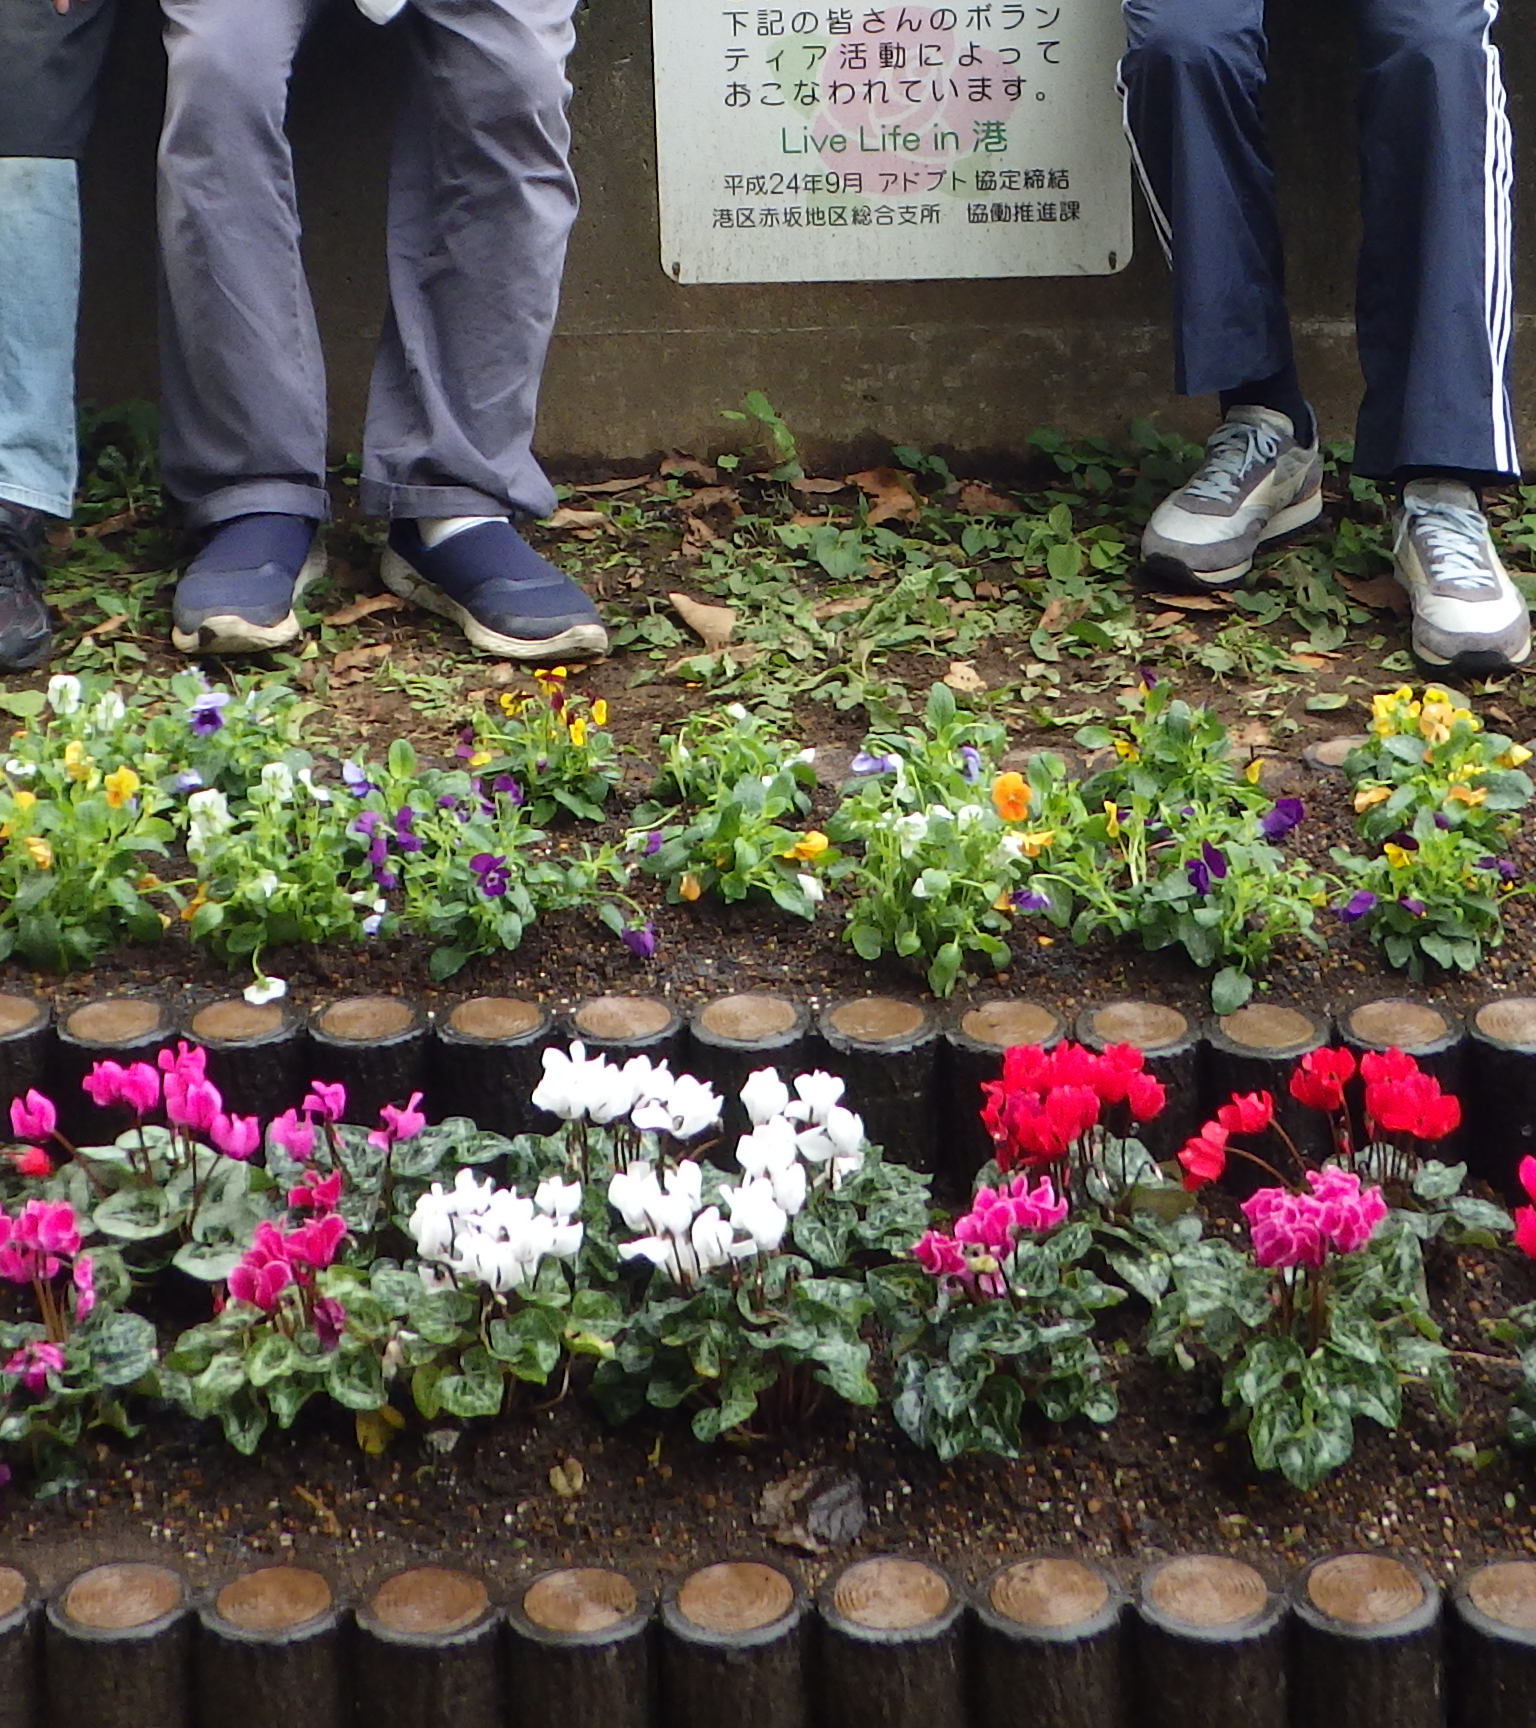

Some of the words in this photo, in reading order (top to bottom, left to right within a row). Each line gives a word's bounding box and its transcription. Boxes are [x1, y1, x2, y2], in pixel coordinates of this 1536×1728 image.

[722, 3, 1061, 37] 下記の皆さんのボラン
[723, 40, 1061, 72] ティア活動によって
[723, 76, 1047, 108] おこなわれています。
[781, 125, 848, 154] Live
[859, 123, 921, 153] Life
[933, 123, 960, 152] in
[972, 120, 1008, 153] 港
[723, 172, 863, 196] 平成24年9月
[712, 203, 941, 229] 港区赤坂地区総合支所
[967, 200, 1081, 224] 協働推進課
